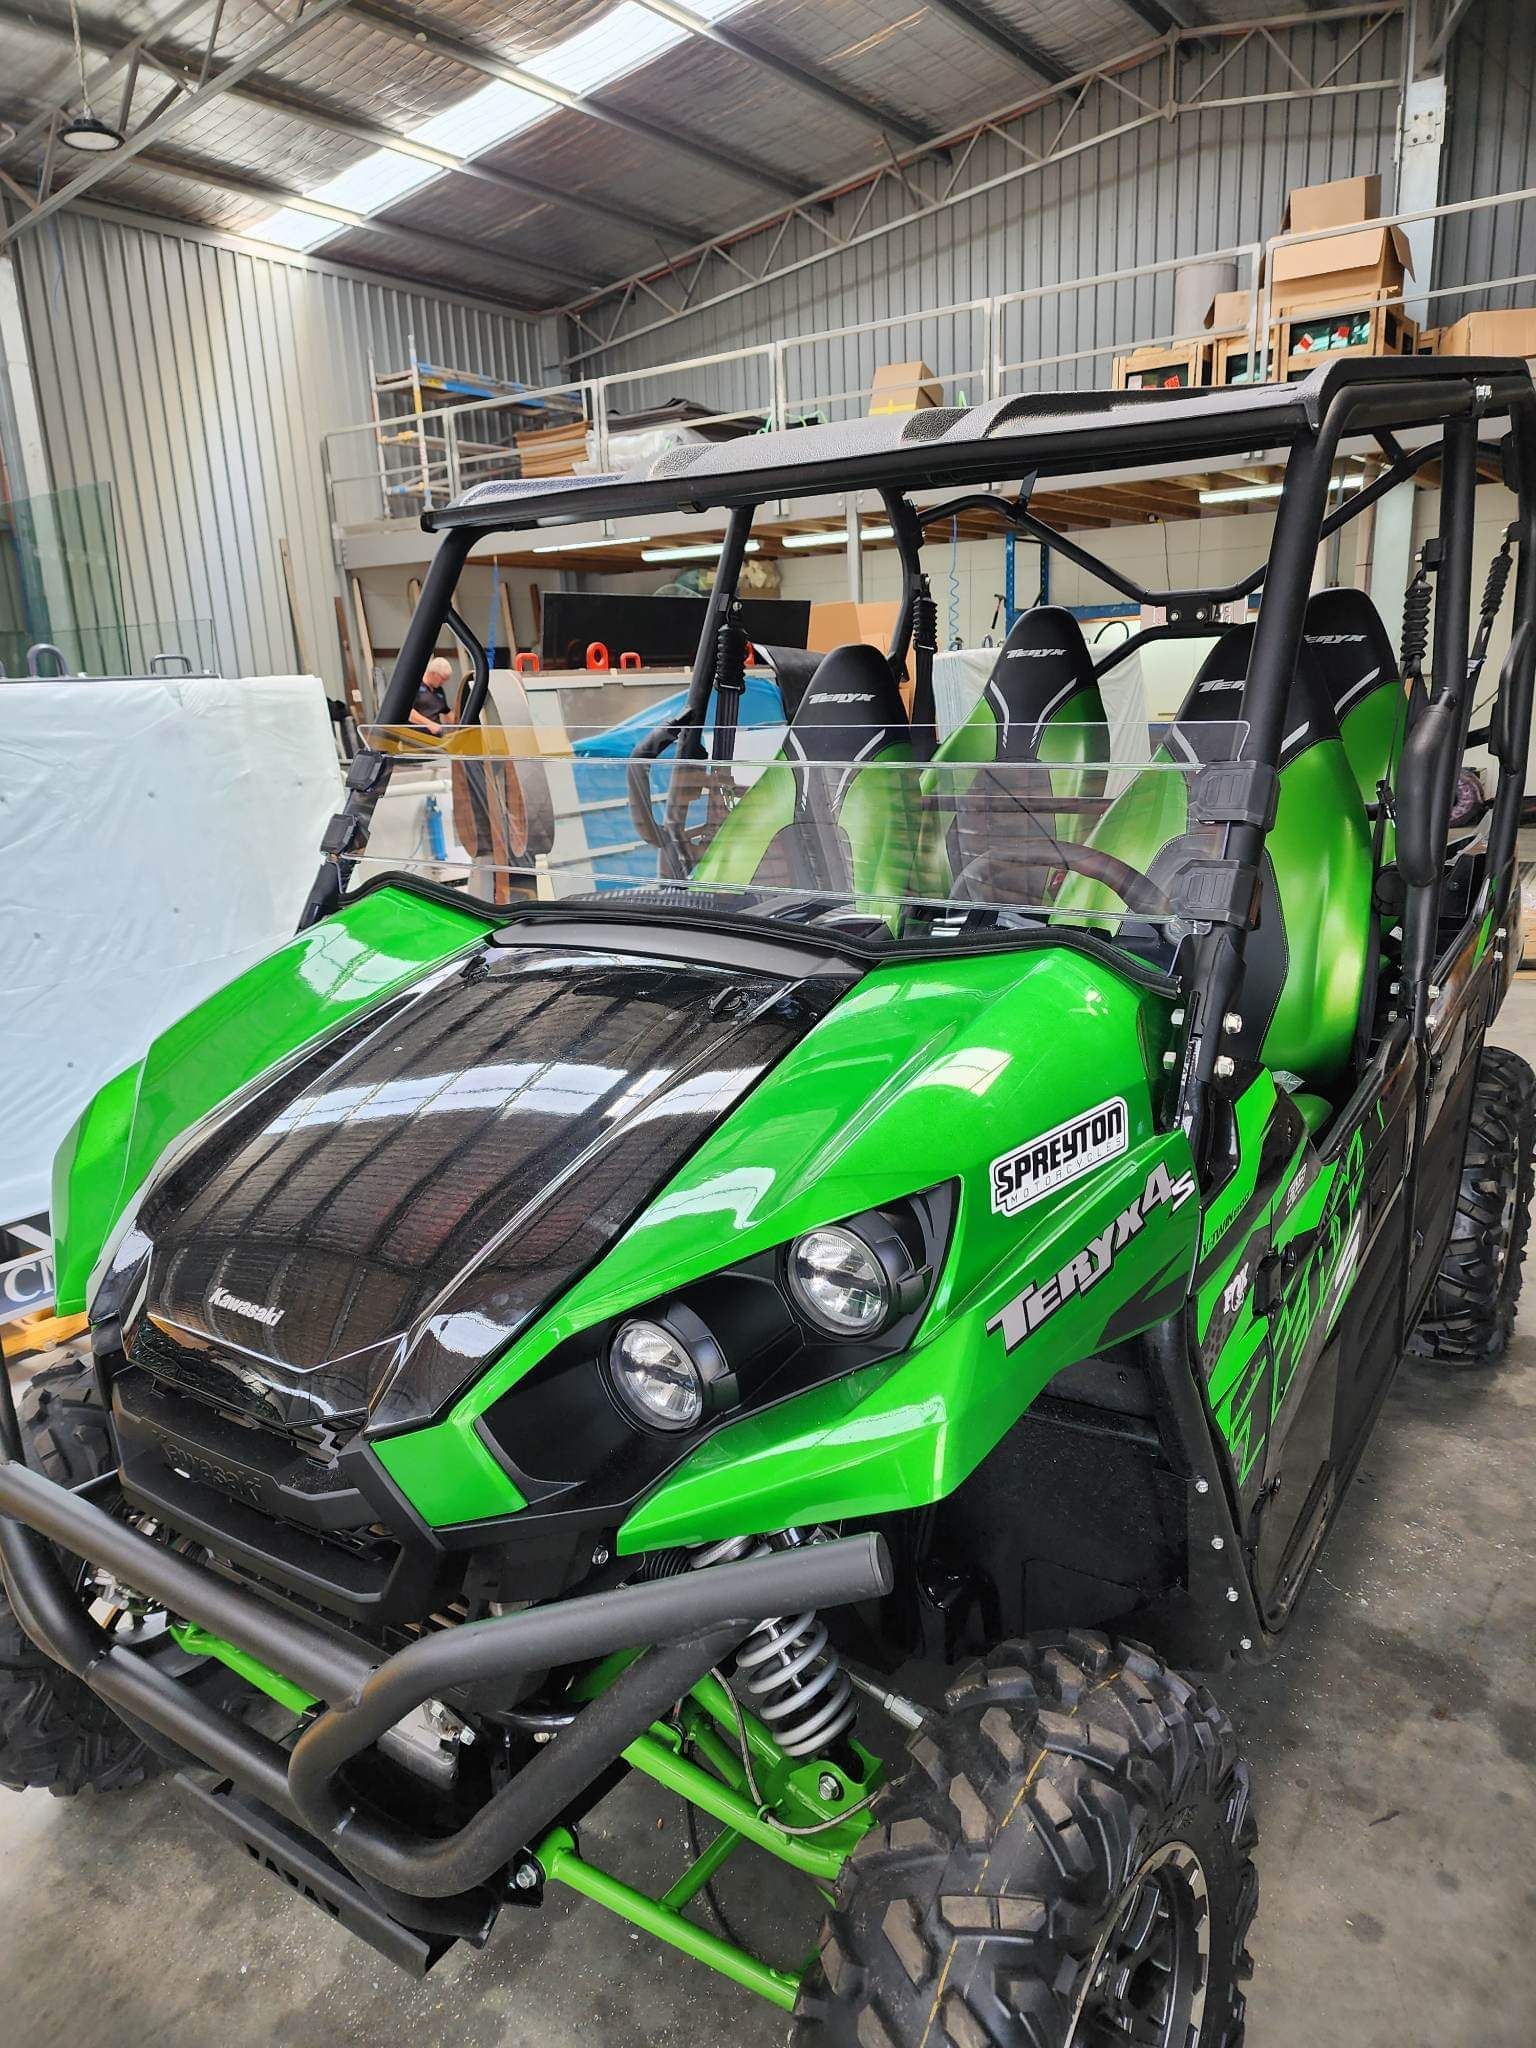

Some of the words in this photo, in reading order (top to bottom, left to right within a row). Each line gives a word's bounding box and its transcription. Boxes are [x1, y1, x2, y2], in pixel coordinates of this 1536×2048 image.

[1303, 634, 1368, 645] ERYX
[1006, 648, 1067, 660] TERYX
[808, 692, 876, 705] TERYX
[997, 1106, 1122, 1199] SPREYTON
[1010, 1136, 1122, 1204] MOTORCYCLES
[208, 1287, 286, 1327] Kawasaki
